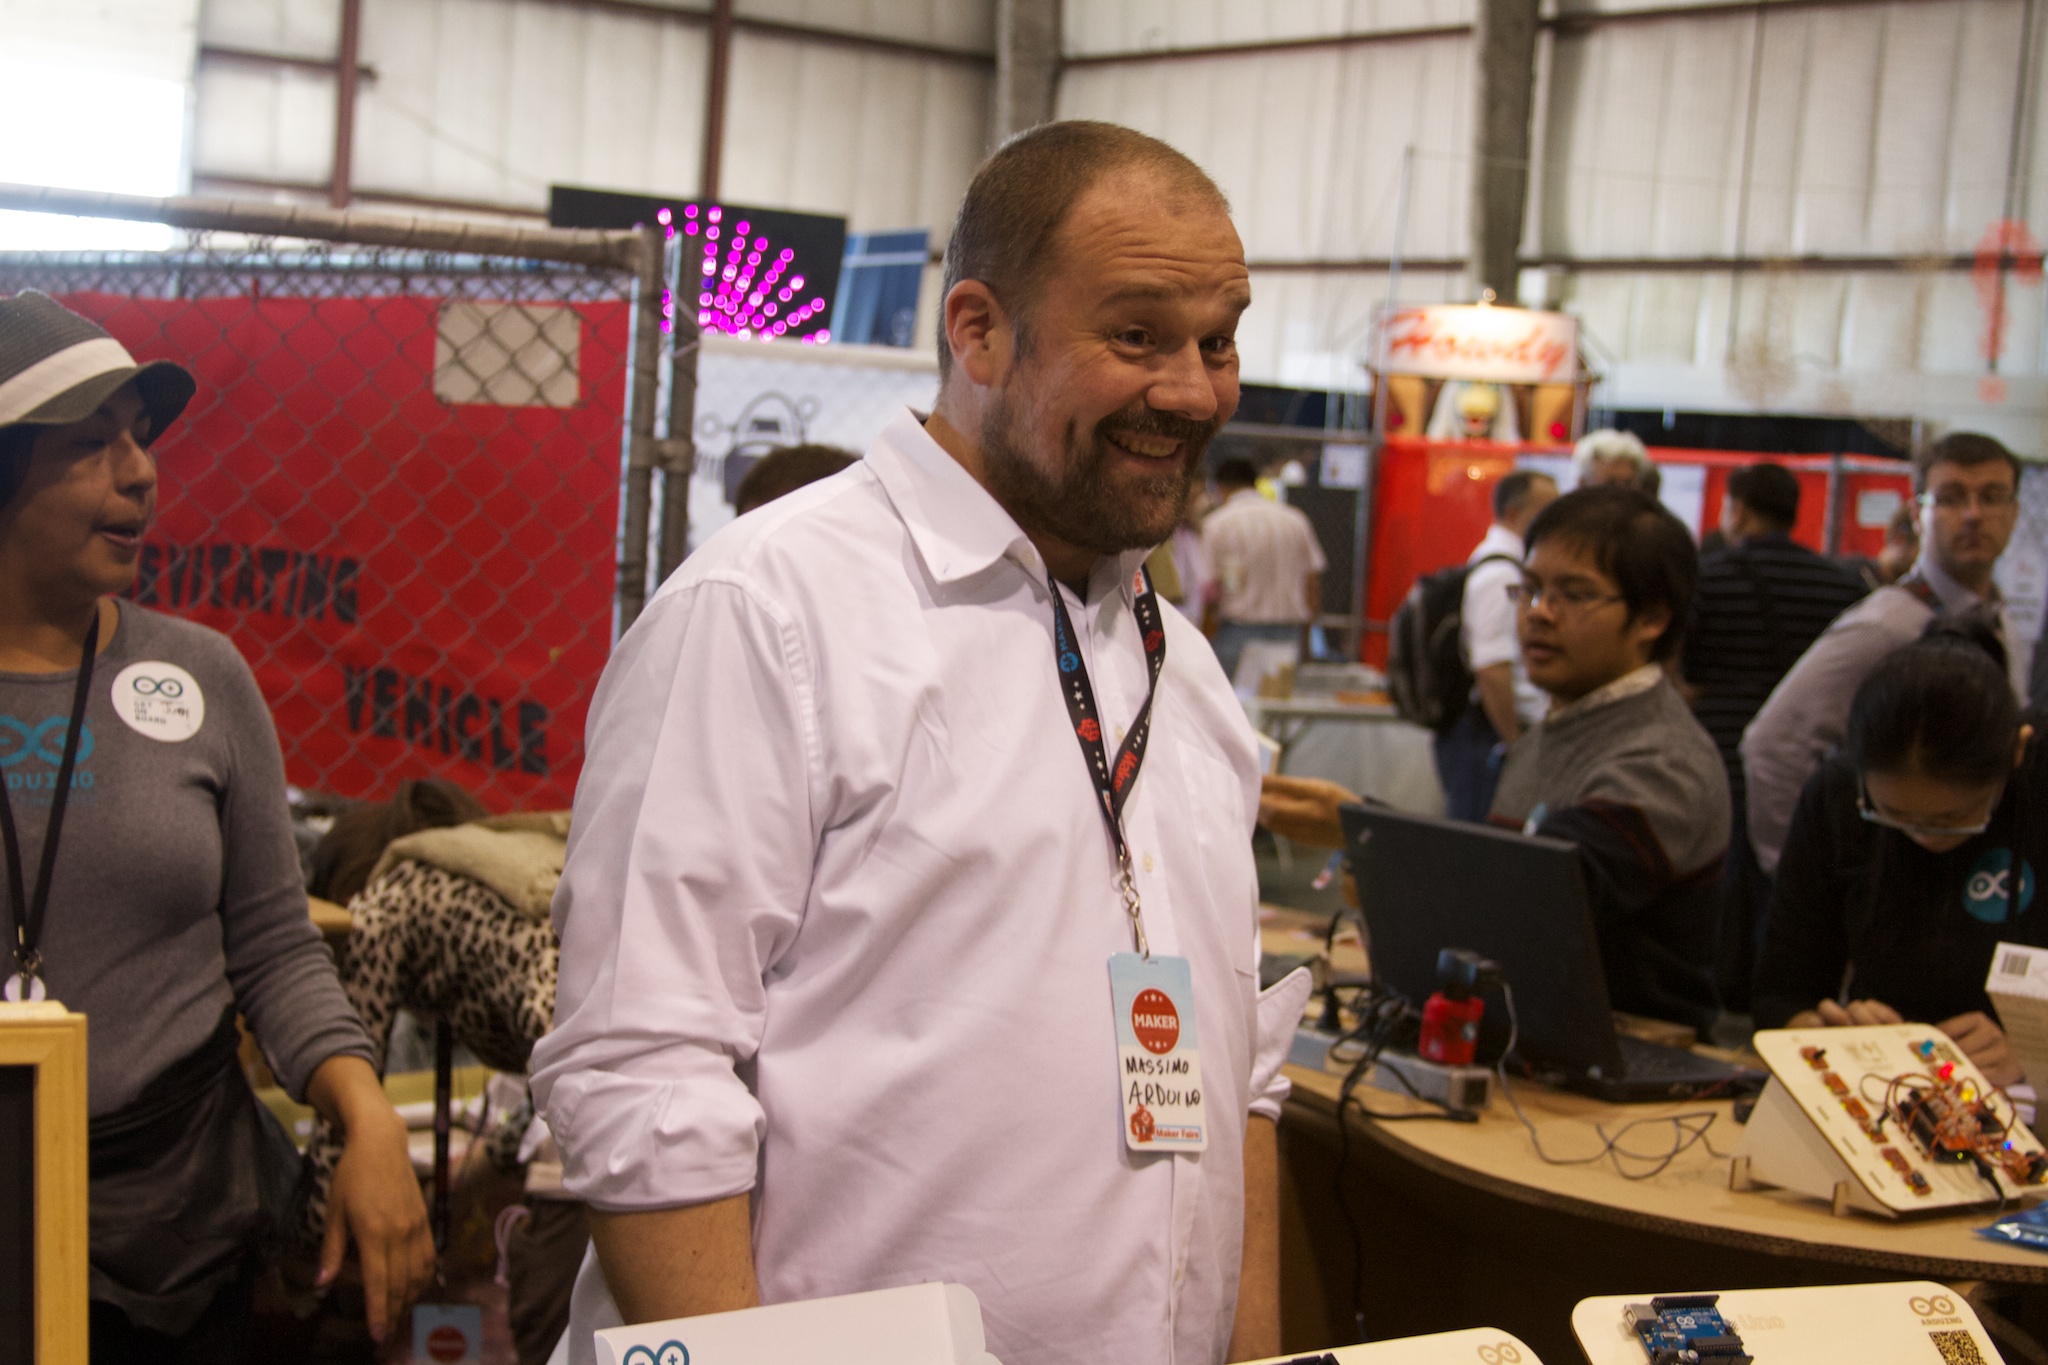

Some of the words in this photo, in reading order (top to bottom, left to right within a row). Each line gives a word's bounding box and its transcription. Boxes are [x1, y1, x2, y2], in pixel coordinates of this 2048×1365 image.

[120, 543, 358, 624] EVITATING
[344, 664, 548, 775] VEHICLE
[1133, 1013, 1178, 1030] MAKER
[1125, 1056, 1190, 1075] MASSIMO
[1155, 1127, 1179, 1138] Maker
[1181, 1127, 1200, 1138] Faire
[1736, 1313, 1786, 1331] Uno
[1920, 1316, 1964, 1326] ARDUINO
